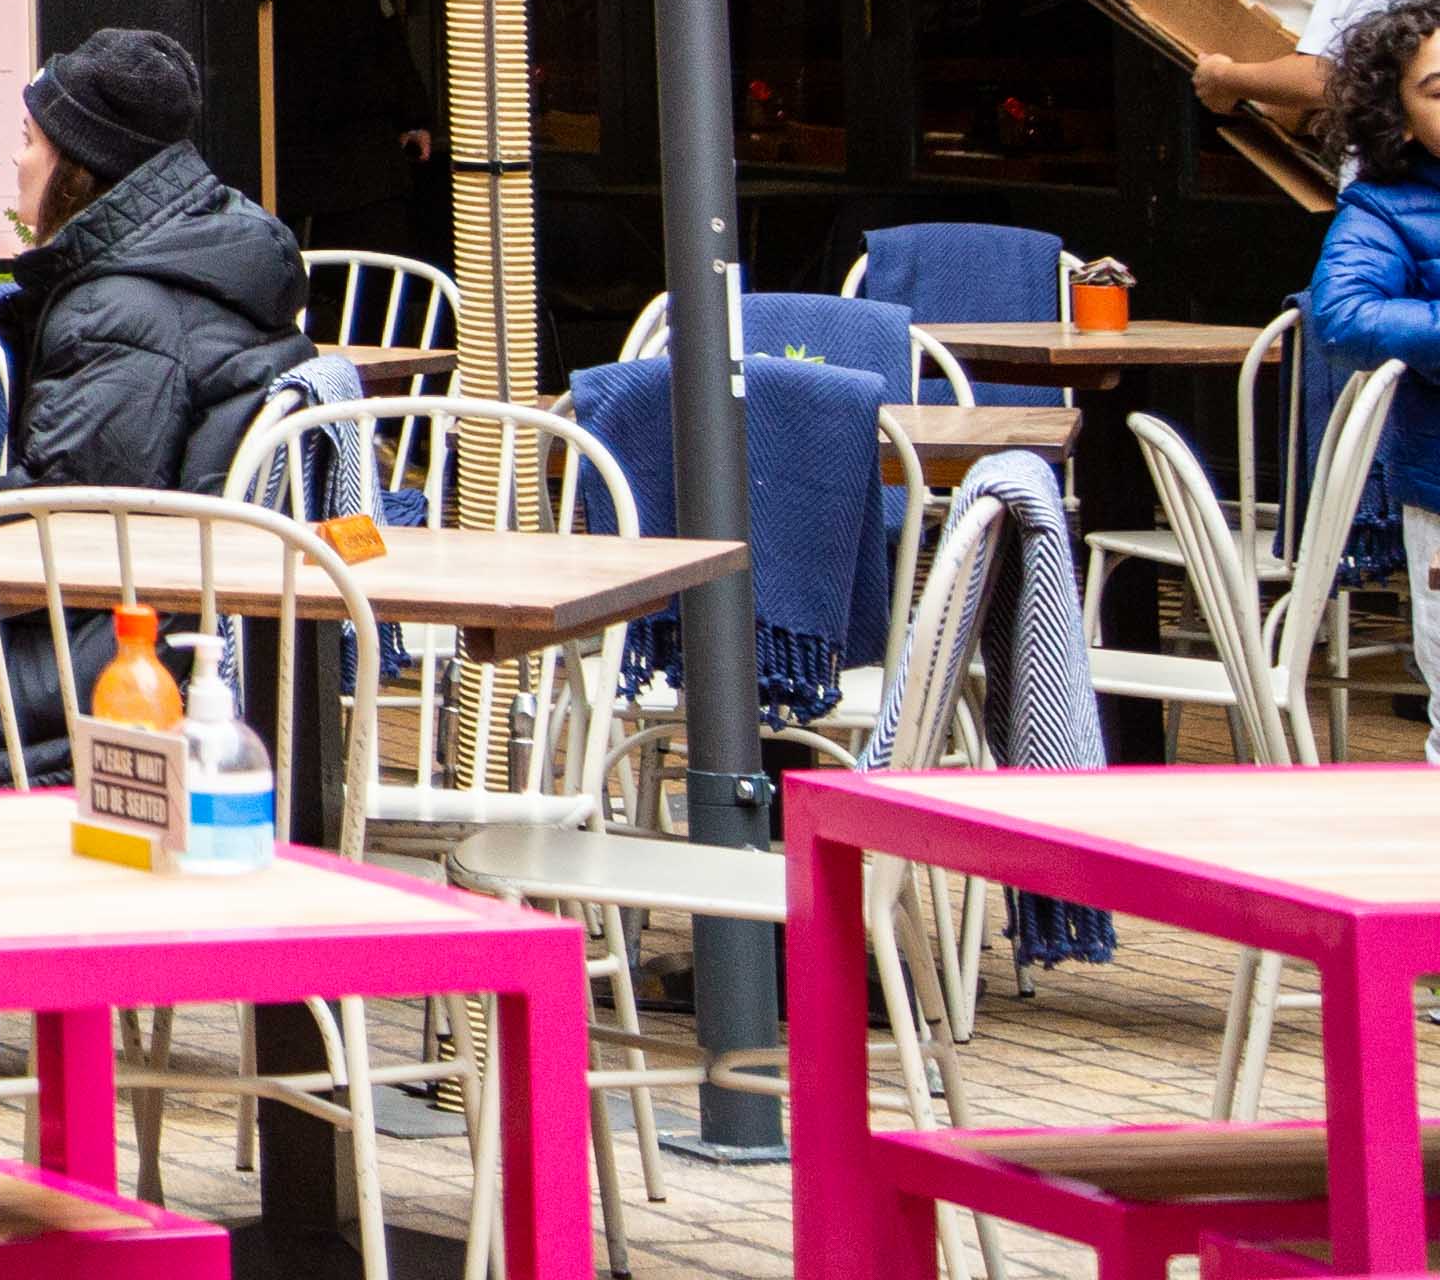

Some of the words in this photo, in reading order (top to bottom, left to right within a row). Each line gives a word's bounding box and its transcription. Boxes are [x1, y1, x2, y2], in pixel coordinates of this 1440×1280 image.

[93, 743, 135, 777] PLEASE
[135, 752, 163, 784] WAIT
[94, 782, 108, 811] TO
[109, 785, 125, 815] BE
[126, 790, 167, 824] SEATED
